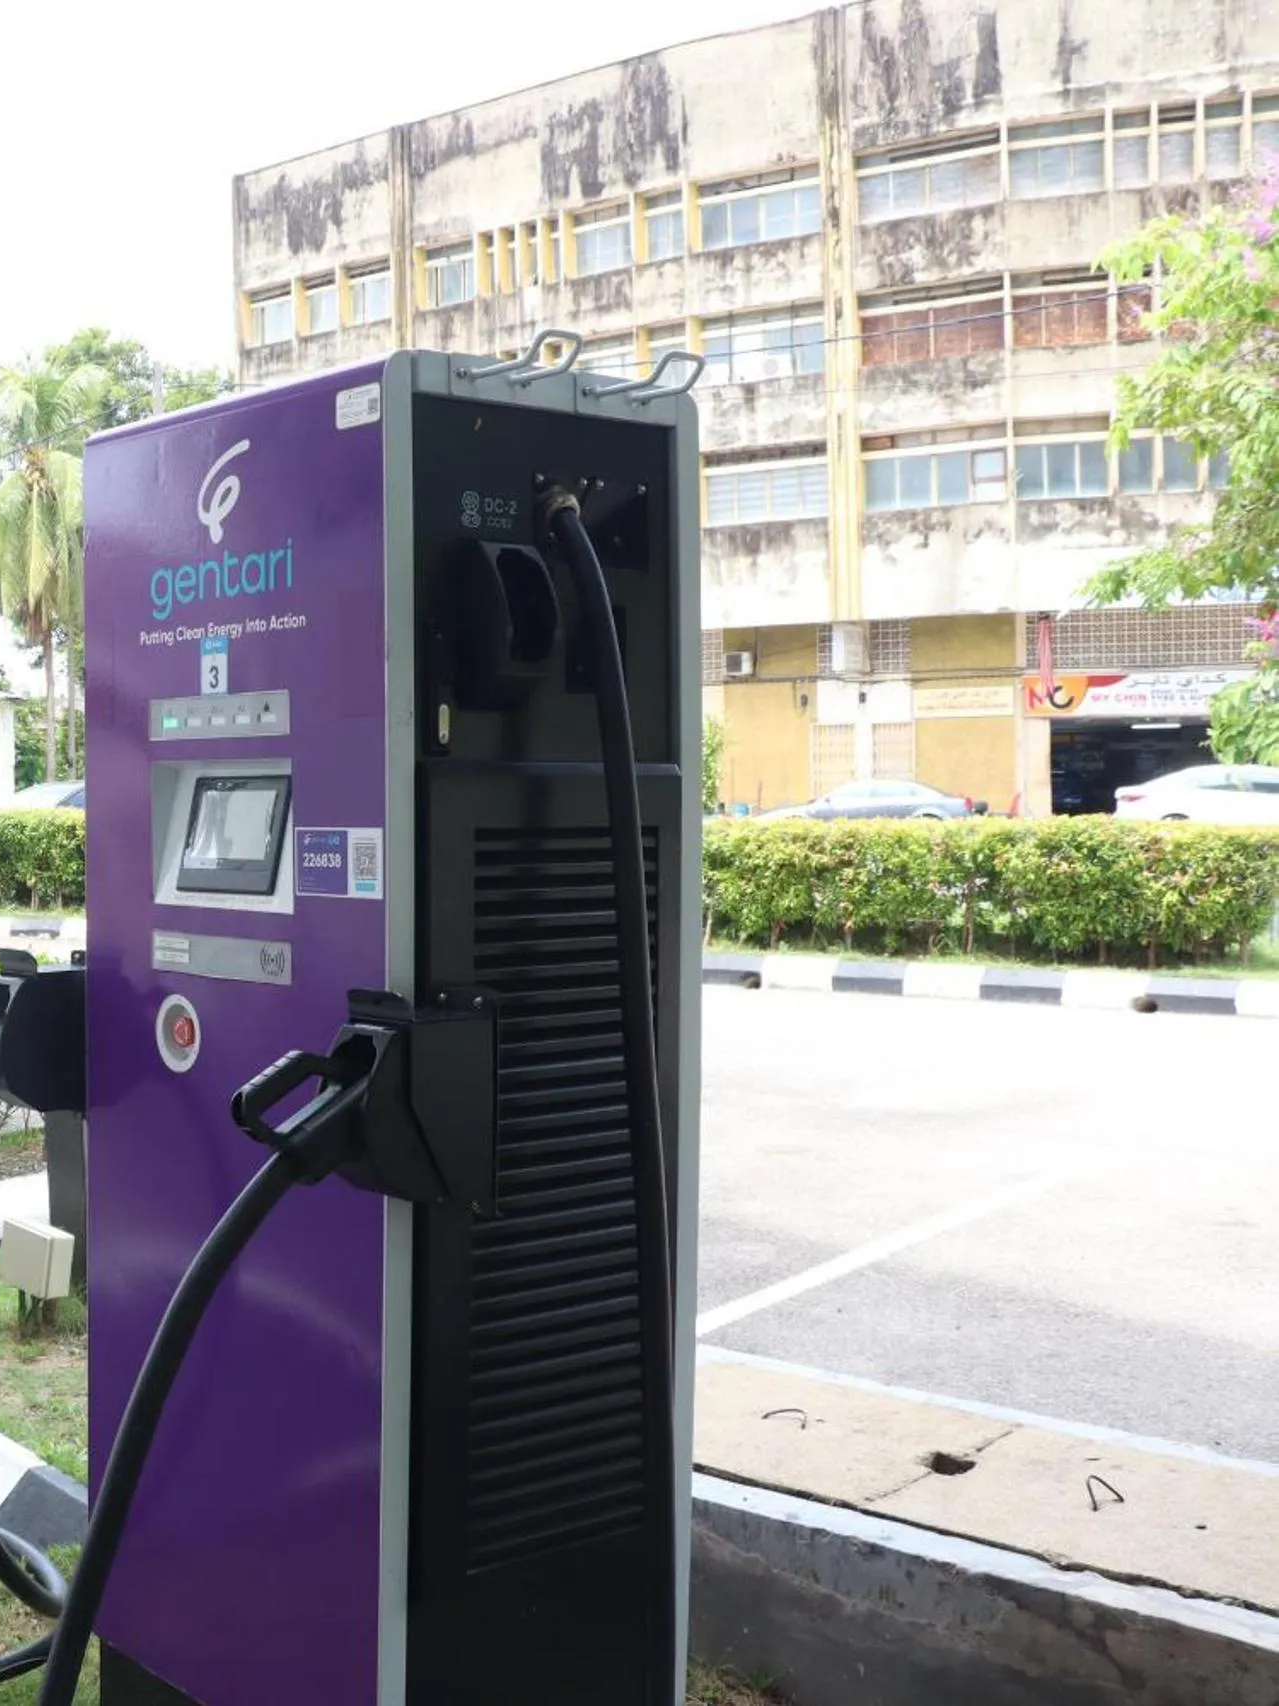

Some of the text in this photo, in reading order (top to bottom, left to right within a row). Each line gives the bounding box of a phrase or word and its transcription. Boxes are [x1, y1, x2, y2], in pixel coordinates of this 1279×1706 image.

[151, 537, 293, 620] gentari
[140, 612, 306, 647] Putting Clean Energy Into Action
[208, 665, 220, 689] 3
[302, 852, 342, 868] 226838
